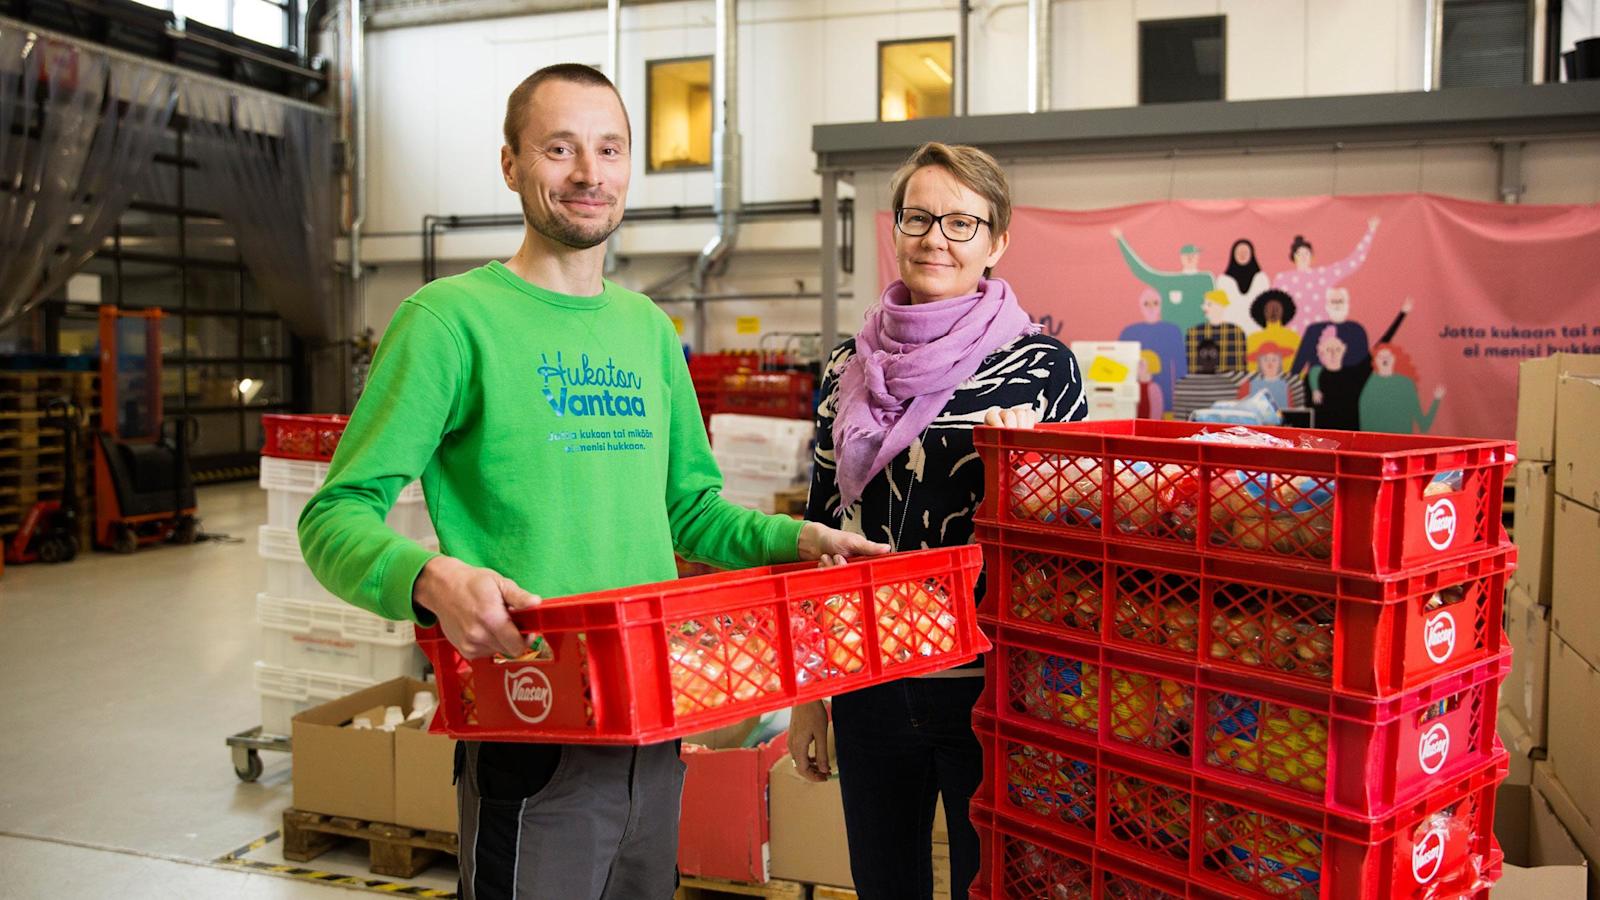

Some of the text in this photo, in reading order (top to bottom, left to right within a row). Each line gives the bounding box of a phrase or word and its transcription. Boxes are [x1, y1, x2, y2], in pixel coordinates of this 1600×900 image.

[1439, 325, 1486, 339] Jotta
[1490, 325, 1556, 339] kukaan
[1561, 323, 1587, 338] tai
[1463, 344, 1480, 358] ei
[1484, 344, 1541, 358] menisi
[537, 351, 642, 390] Hukaton
[542, 387, 646, 417] Vantaa
[579, 429, 611, 440] kukaan
[613, 429, 625, 439] tai
[512, 676, 549, 708] Vaasan
